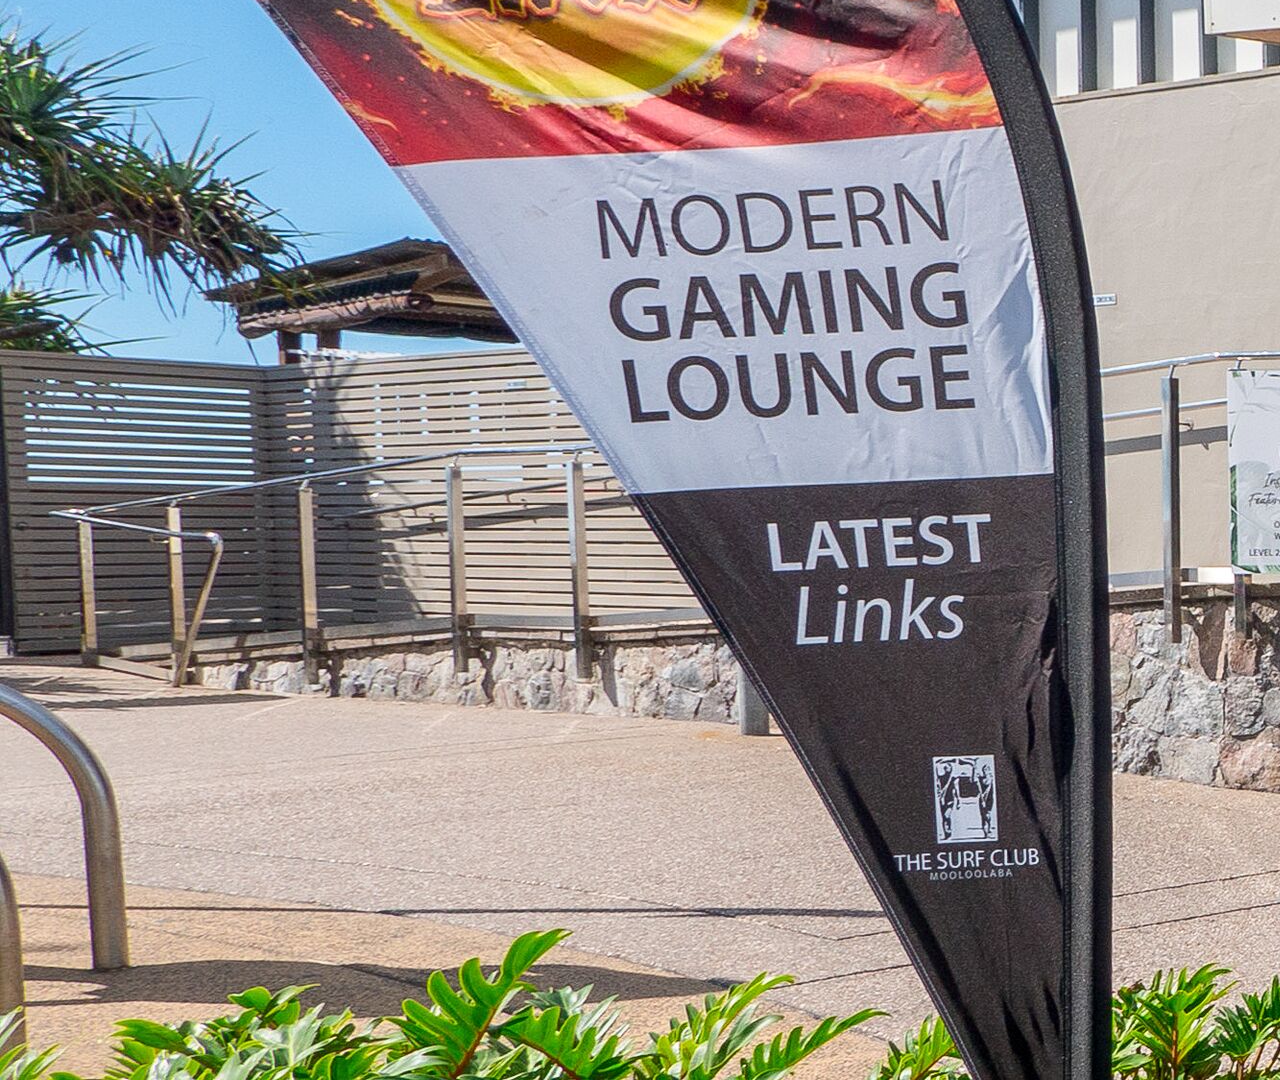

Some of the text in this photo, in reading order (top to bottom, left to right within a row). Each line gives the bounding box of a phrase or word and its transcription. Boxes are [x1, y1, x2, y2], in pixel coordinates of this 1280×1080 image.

[595, 179, 951, 260] MODERN
[609, 260, 968, 341] GAMING
[621, 344, 975, 423] LOUNGE
[767, 514, 991, 572] LATEST
[1249, 548, 1274, 557] LEVEL
[796, 578, 964, 645] Links
[894, 848, 1040, 871] THE SURF CLUB
[929, 868, 1013, 881] MOOLOOLABA
